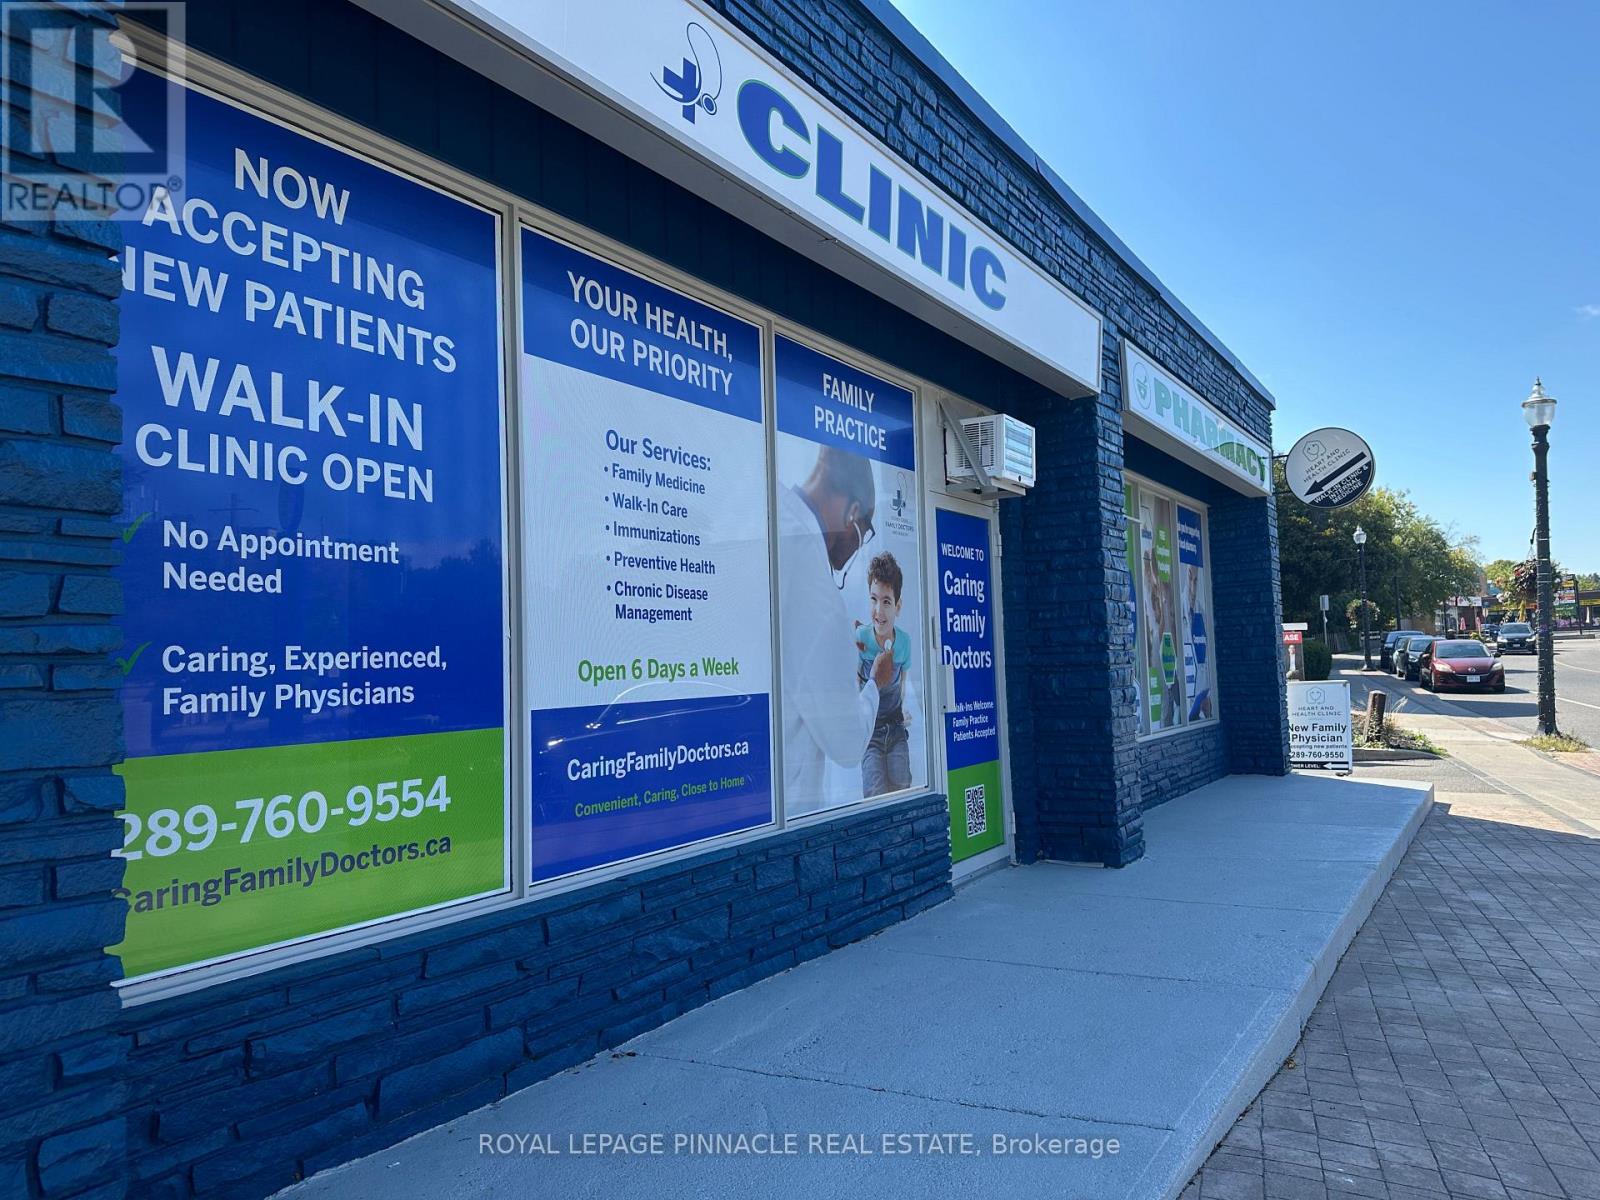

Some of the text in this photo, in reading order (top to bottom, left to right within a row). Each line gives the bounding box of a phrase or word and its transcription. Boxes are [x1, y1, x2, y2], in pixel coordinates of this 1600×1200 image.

[235, 147, 350, 226] NOW
[736, 79, 1007, 312] CLINIC
[142, 186, 425, 310] ACCEPTING
[246, 279, 457, 374] PATIENTS
[567, 270, 733, 363] YOUR HEALTH,
[570, 318, 733, 396] OUR PRIORITY
[151, 346, 423, 451] WALK-IN
[823, 373, 875, 413] FAMILY
[814, 405, 887, 451] PRACTICE
[135, 423, 433, 503] CLINIC OPEN
[606, 429, 711, 471] Our Services:
[1304, 449, 1351, 483] HEALTH CLINIC
[1306, 448, 1340, 474] HEART AND
[612, 463, 706, 495] Family Medicine
[1328, 478, 1361, 500] INTERNAL
[1332, 481, 1363, 504] MEDICINE
[1341, 469, 1362, 486] CLINIC
[612, 492, 688, 518] Walk-In Care
[163, 519, 400, 565] No Appointment
[613, 521, 701, 546] Immunizations
[614, 551, 716, 575] Preventive Health
[941, 542, 984, 562] WELCOME TO
[163, 562, 282, 594] Needed
[614, 580, 708, 601] Chronic Disease
[943, 570, 985, 603] Caring
[615, 603, 693, 624] Management
[946, 607, 986, 639] Family
[1283, 633, 1299, 641] ASE
[162, 645, 447, 678] Caring, Experienced,
[578, 657, 739, 687] Open 6 Days a Week
[943, 645, 992, 669] Doctors
[163, 682, 415, 718] Family Physicians
[1291, 733, 1343, 745] Physician
[1312, 722, 1347, 734] Family
[567, 740, 749, 781] CaringFamilyDoctors.ca
[1290, 751, 1345, 759] 289-760-9550
[575, 776, 745, 818] Convenient, Caring, Close to Home
[110, 775, 451, 861] 289-760-9554
